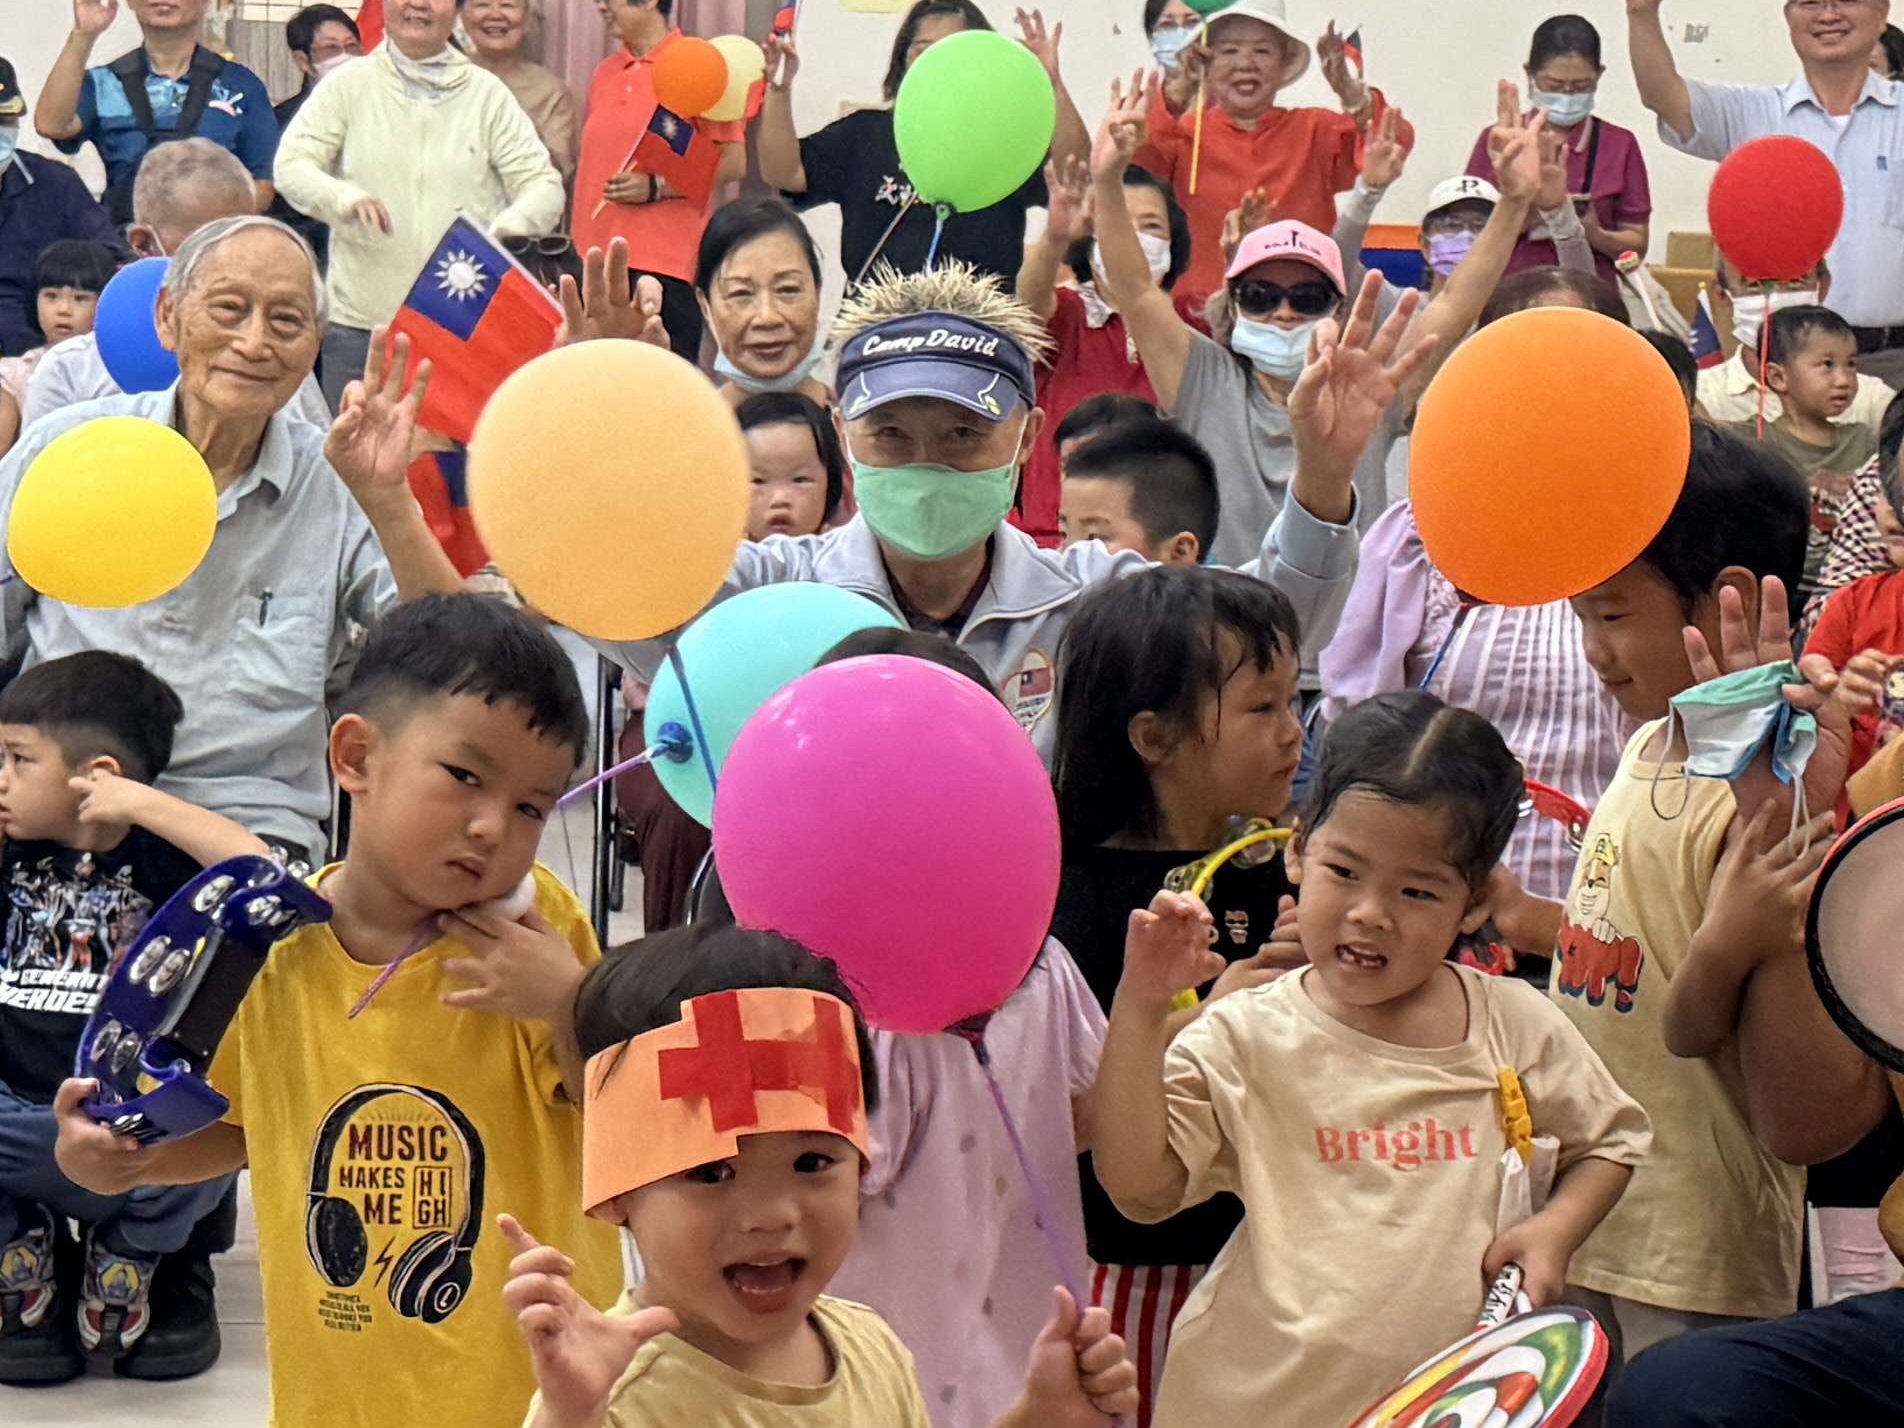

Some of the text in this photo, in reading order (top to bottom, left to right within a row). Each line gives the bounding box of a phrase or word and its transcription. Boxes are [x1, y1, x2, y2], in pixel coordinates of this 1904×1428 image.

[348, 1123, 448, 1162] MUSIC
[1314, 1116, 1479, 1172] Bright
[339, 1166, 405, 1189] MAKES
[364, 1193, 403, 1225] ME
